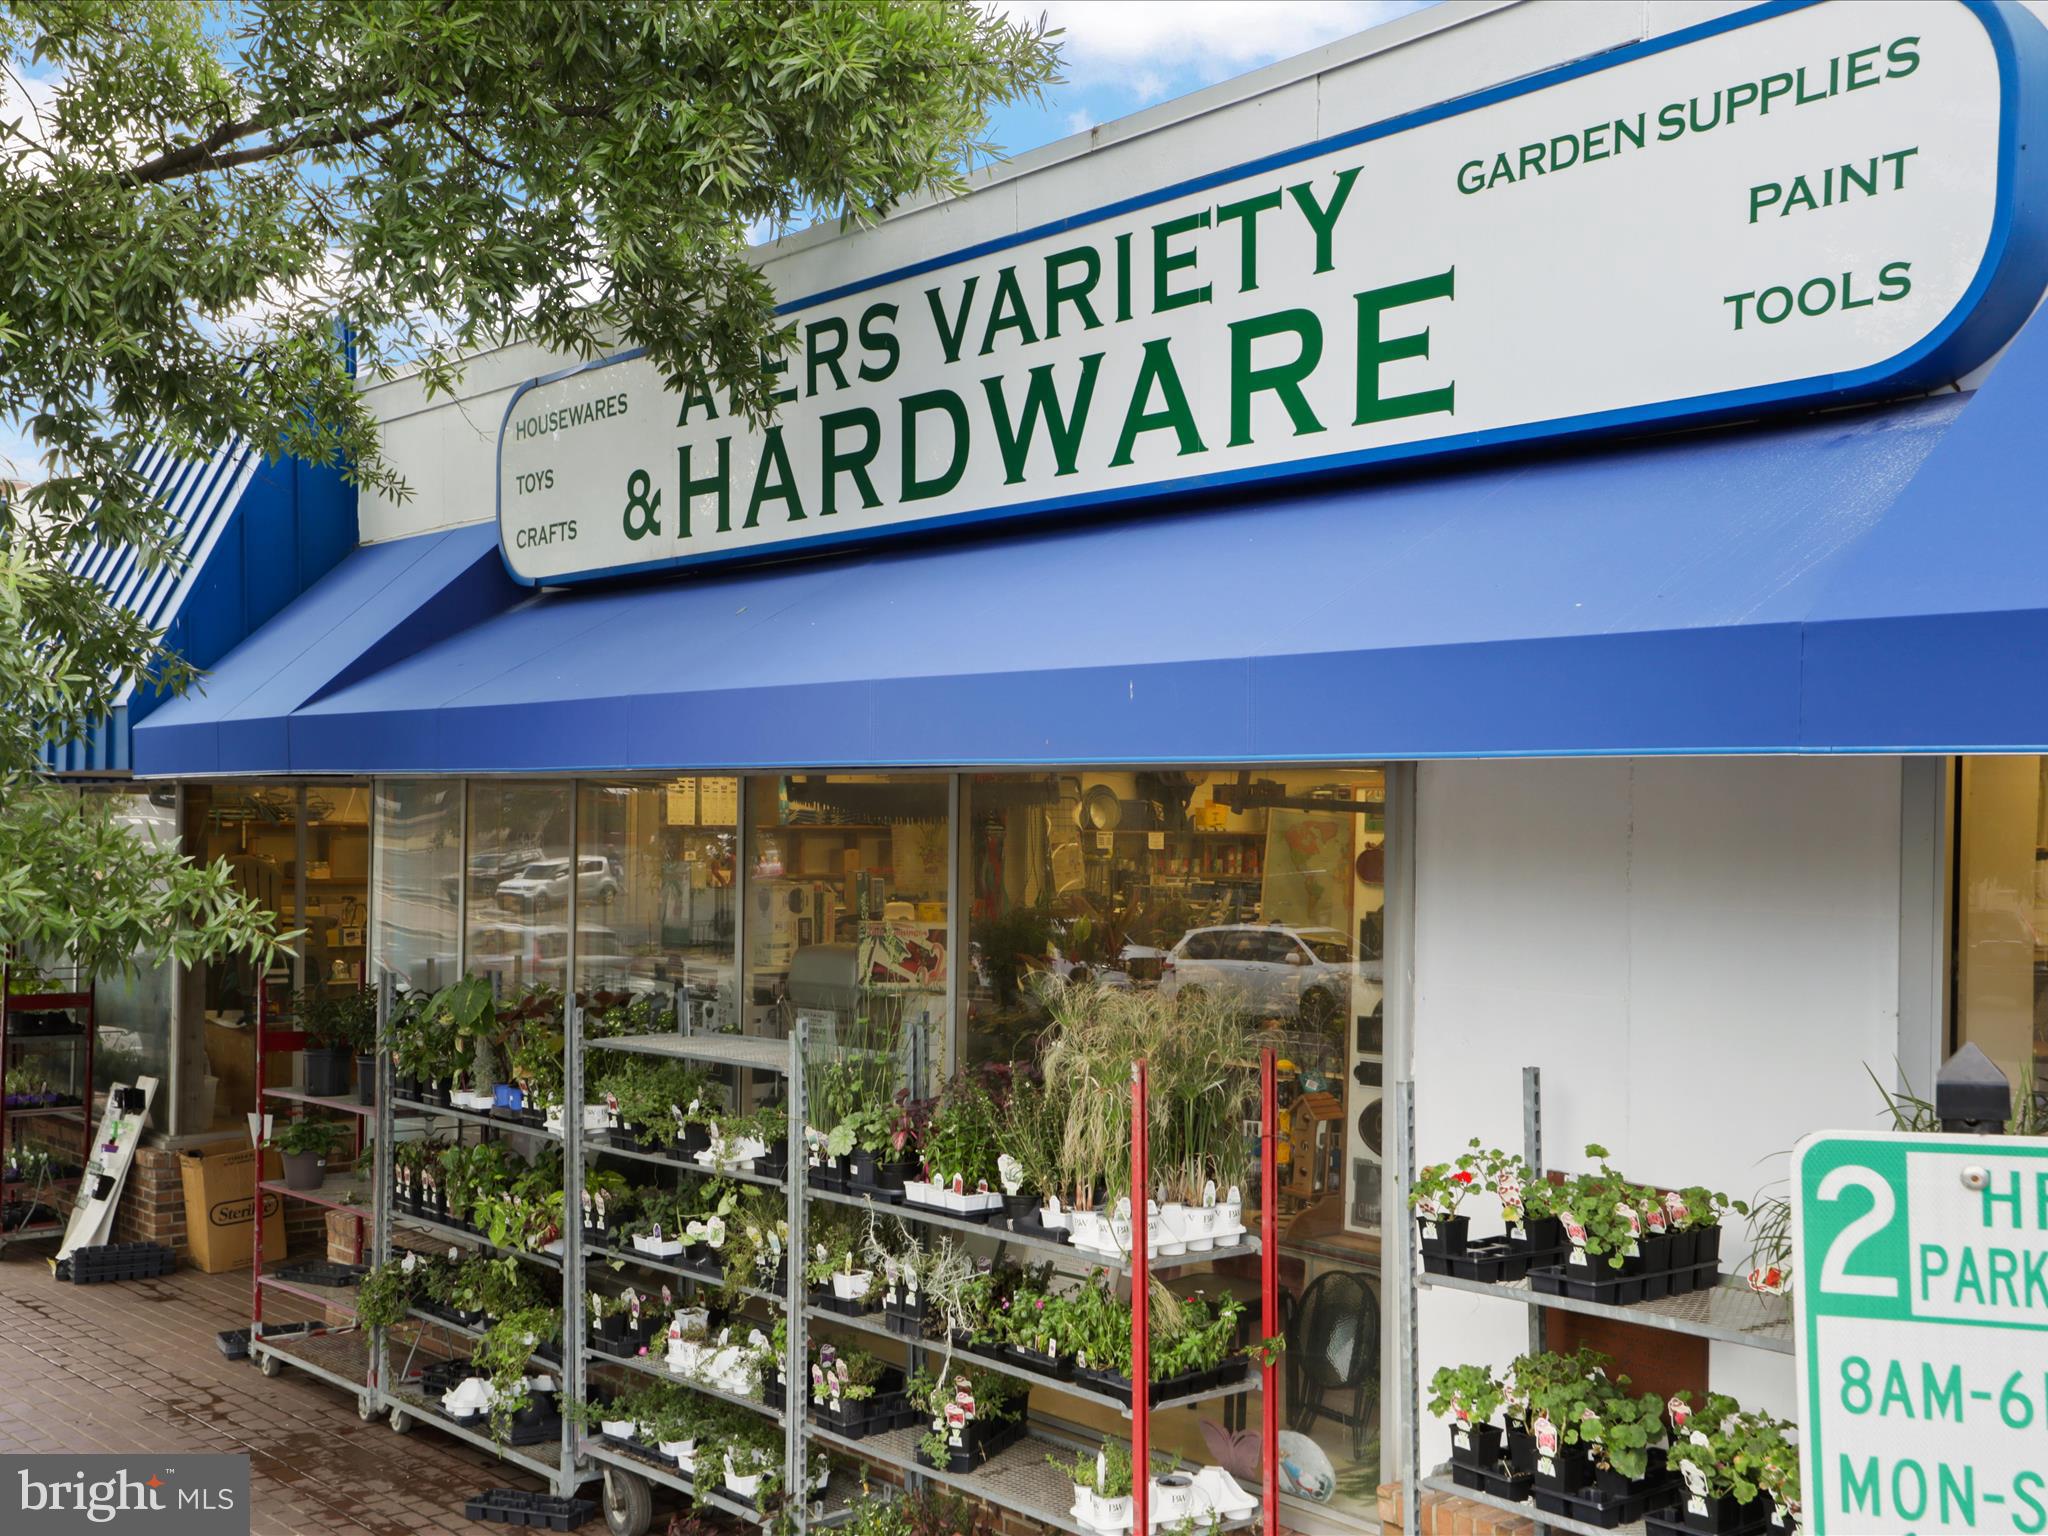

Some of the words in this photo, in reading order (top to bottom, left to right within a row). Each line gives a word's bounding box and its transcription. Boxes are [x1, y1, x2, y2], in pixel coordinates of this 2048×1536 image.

[1457, 112, 1646, 195] GARDEN
[1657, 36, 1922, 143] SUPPLIES
[1749, 146, 1919, 225] PAINT
[676, 302, 901, 428] AERS
[924, 165, 1365, 365] VARIETY
[1723, 261, 1912, 331] TOOLS
[515, 393, 628, 440] HOUSEWARES
[516, 469, 554, 495] TOYS
[516, 520, 578, 550] CRAFTS
[1816, 1164, 1899, 1298] 2
[1840, 1355, 2048, 1430] 8AM-6
